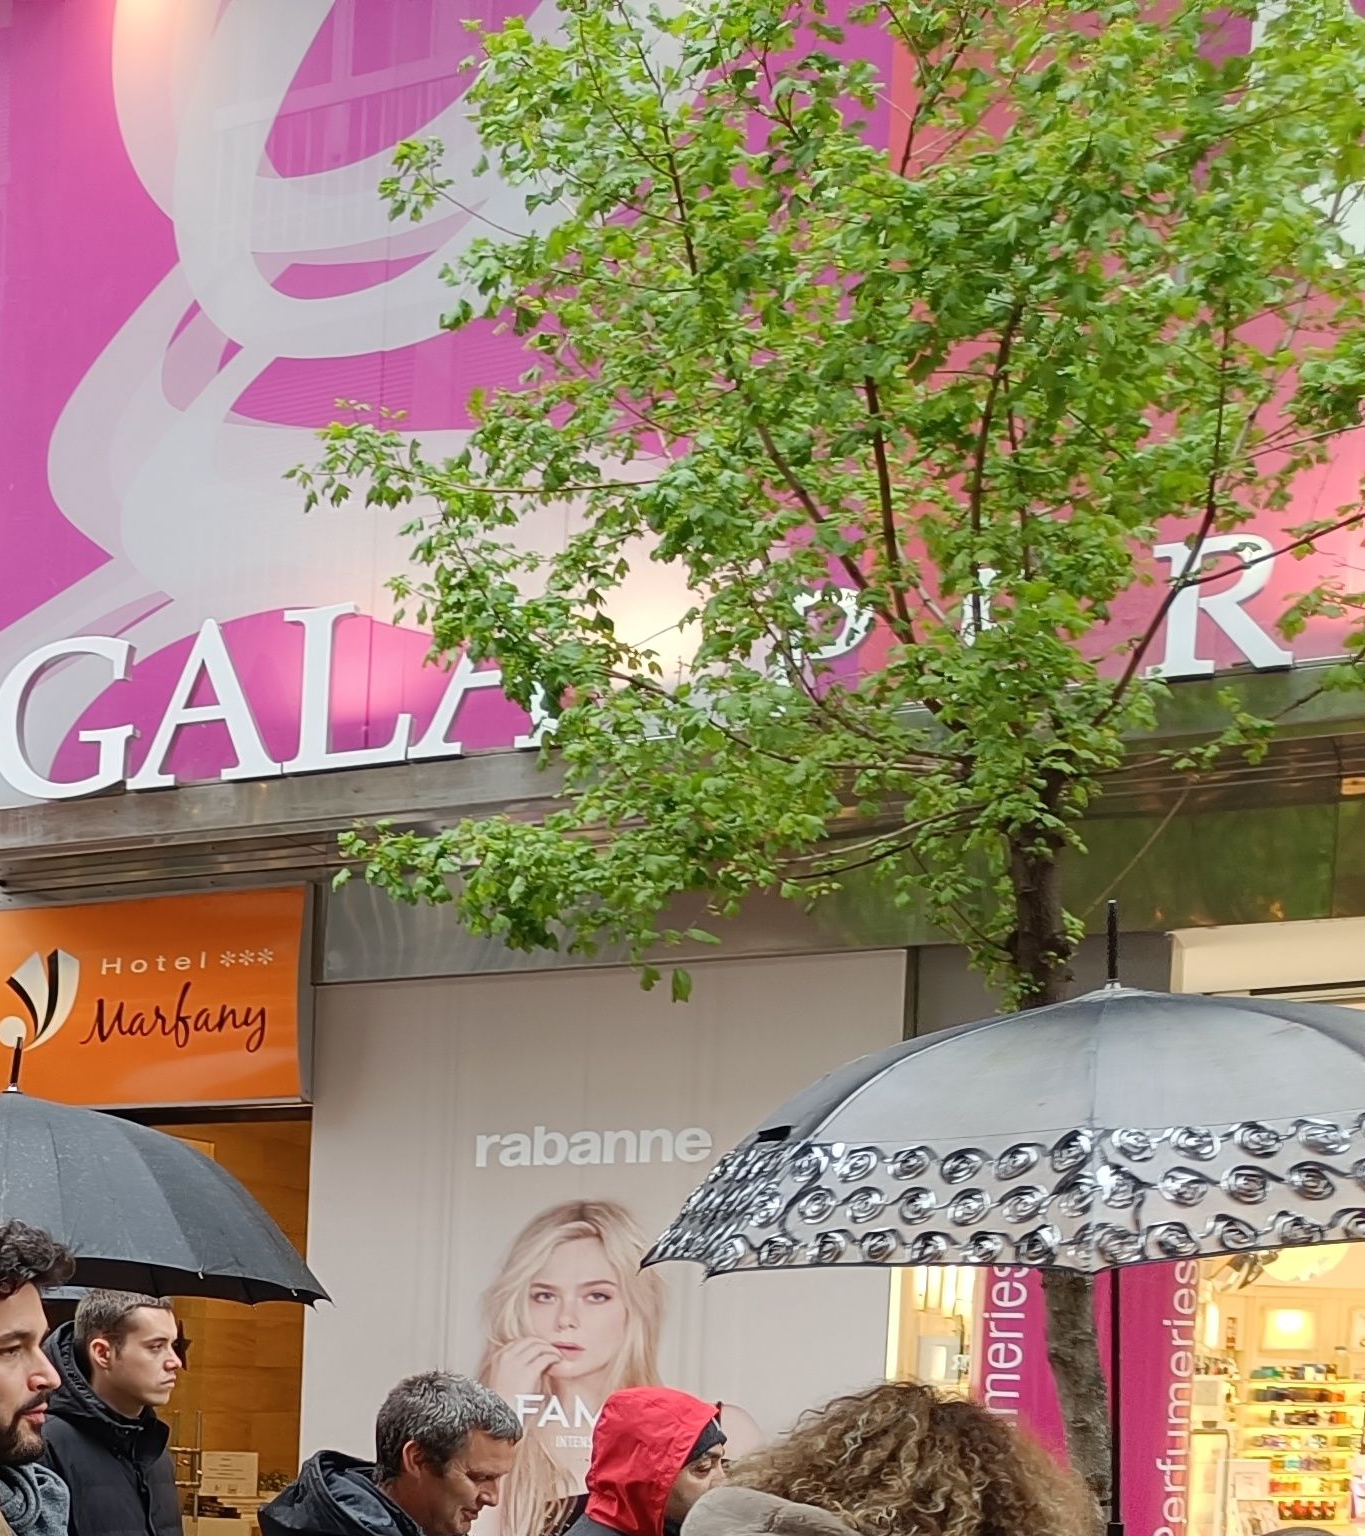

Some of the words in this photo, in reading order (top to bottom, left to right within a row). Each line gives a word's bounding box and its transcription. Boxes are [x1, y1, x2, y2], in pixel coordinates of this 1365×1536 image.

[101, 951, 207, 976] Hotel
[79, 981, 266, 1053] Marfany
[475, 1126, 713, 1168] rabanne
[515, 1394, 602, 1428] FAM
